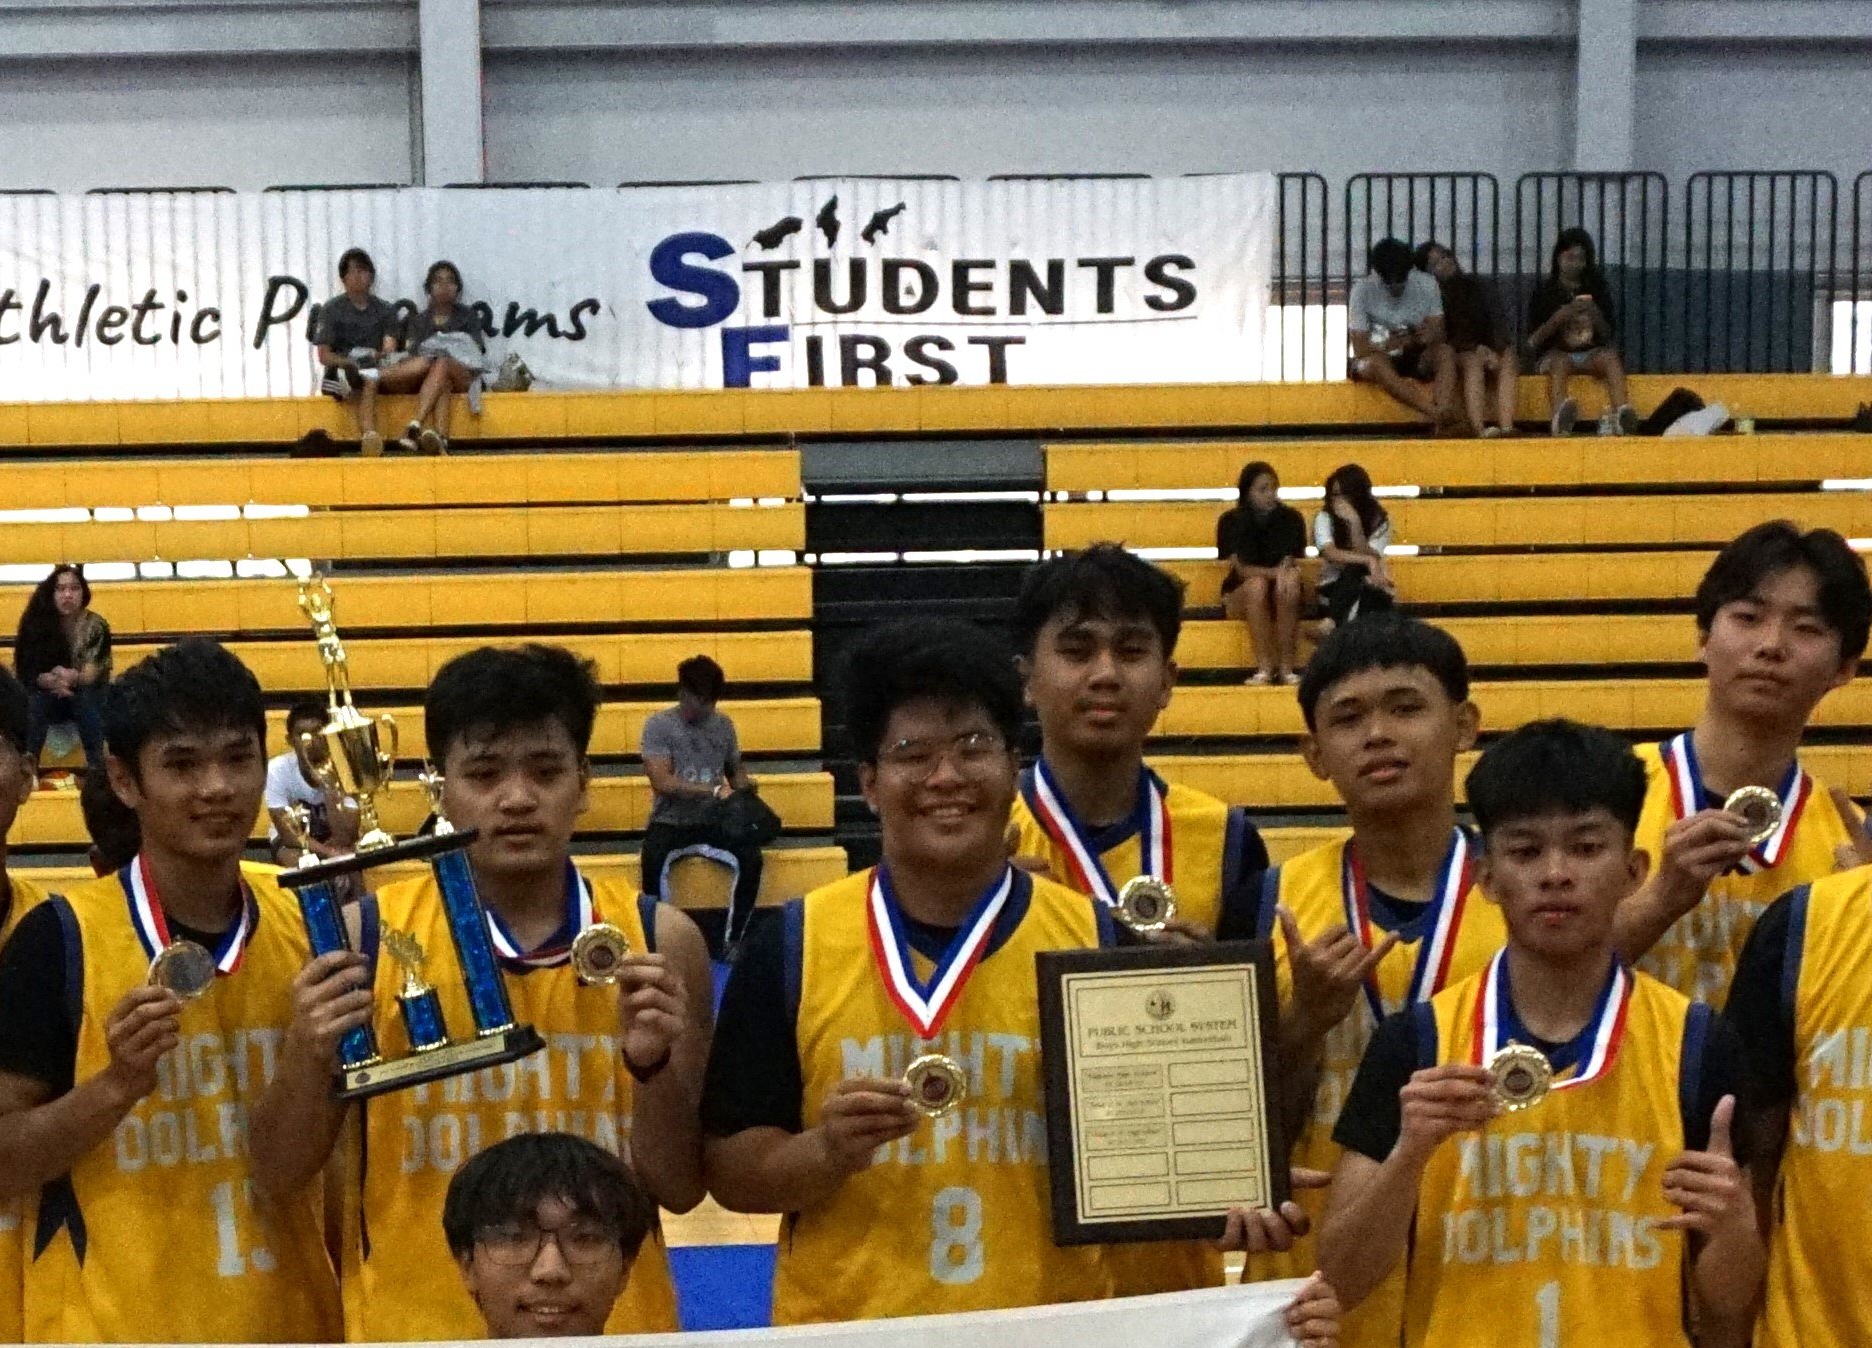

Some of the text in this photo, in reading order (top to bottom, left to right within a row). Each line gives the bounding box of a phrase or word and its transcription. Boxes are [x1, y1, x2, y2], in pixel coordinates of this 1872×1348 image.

[253, 275, 601, 351] Prams
[646, 231, 1199, 329] STUDENTS
[721, 324, 1027, 388] FIRST
[1087, 1018, 1238, 1039] PUBLIC SCHOOL SYSTEM
[930, 1185, 985, 1285] 8
